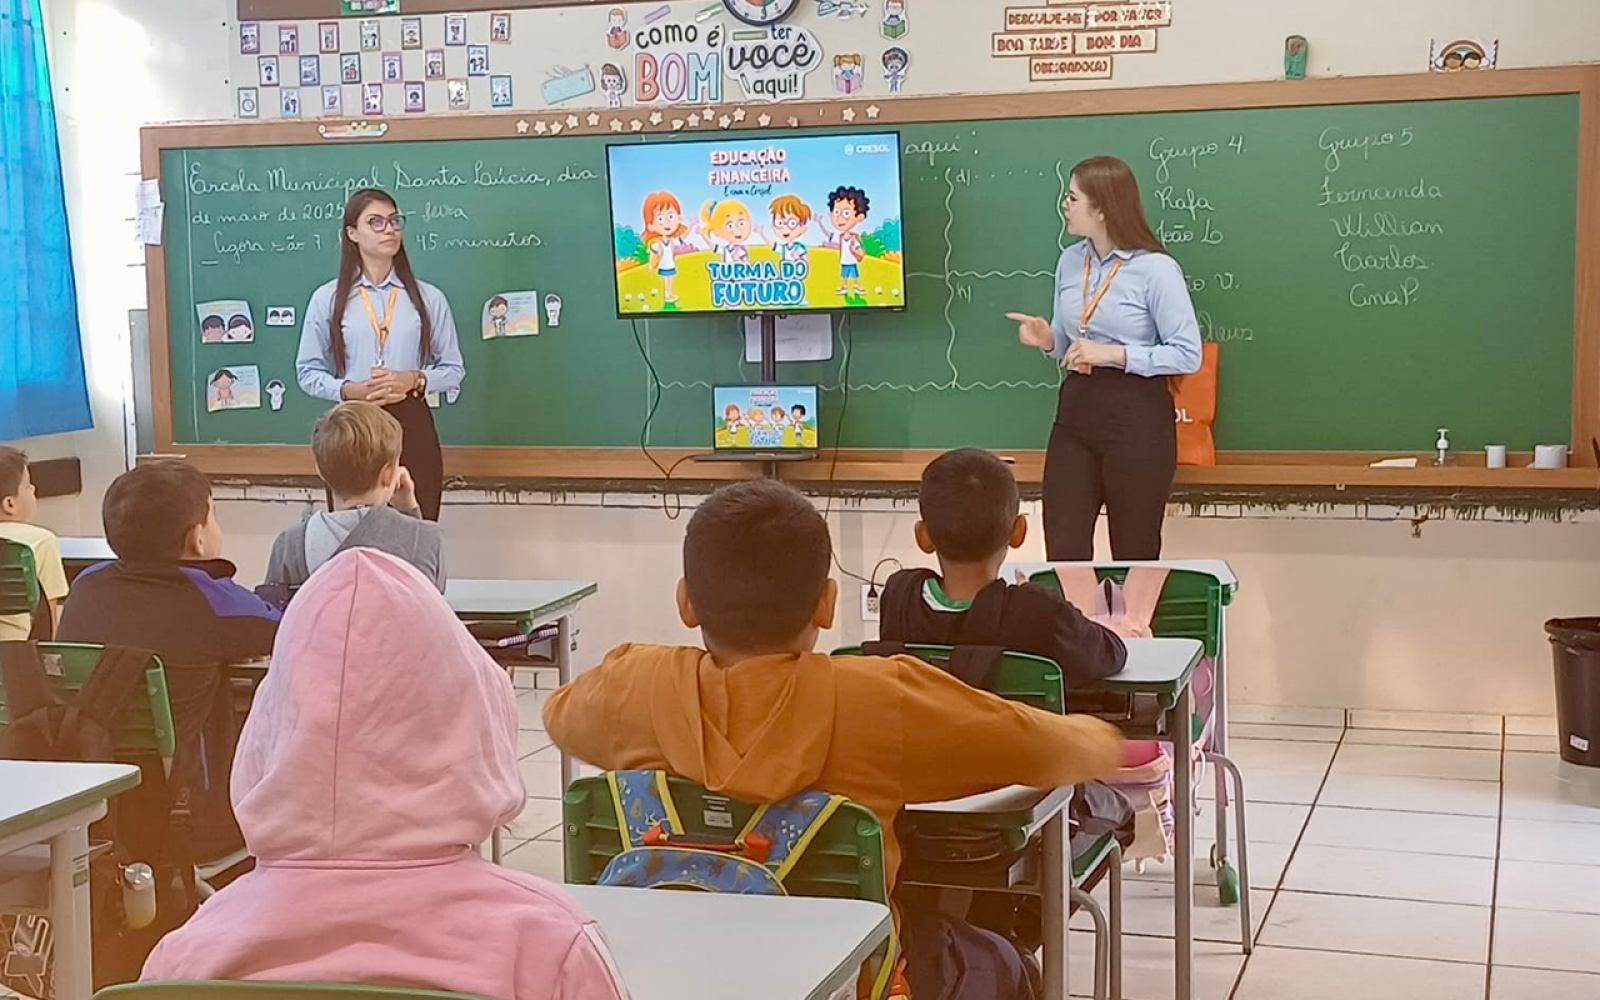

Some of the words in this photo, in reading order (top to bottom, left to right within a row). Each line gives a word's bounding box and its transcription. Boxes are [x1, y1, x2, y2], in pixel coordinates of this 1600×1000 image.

[635, 24, 697, 49] como
[707, 26, 720, 47] é
[772, 22, 791, 40] ter
[728, 33, 815, 70] você
[635, 53, 720, 100] BOM
[753, 74, 798, 98] aqui!
[1399, 126, 1413, 146] 5
[711, 147, 786, 168] EDUCAÇÃO
[708, 169, 789, 185] FINANCEIRA
[303, 203, 346, 221] 2025
[415, 233, 438, 250] 45
[708, 263, 776, 281] TURMA
[782, 261, 808, 279] DO
[713, 282, 804, 306] FUTURO
